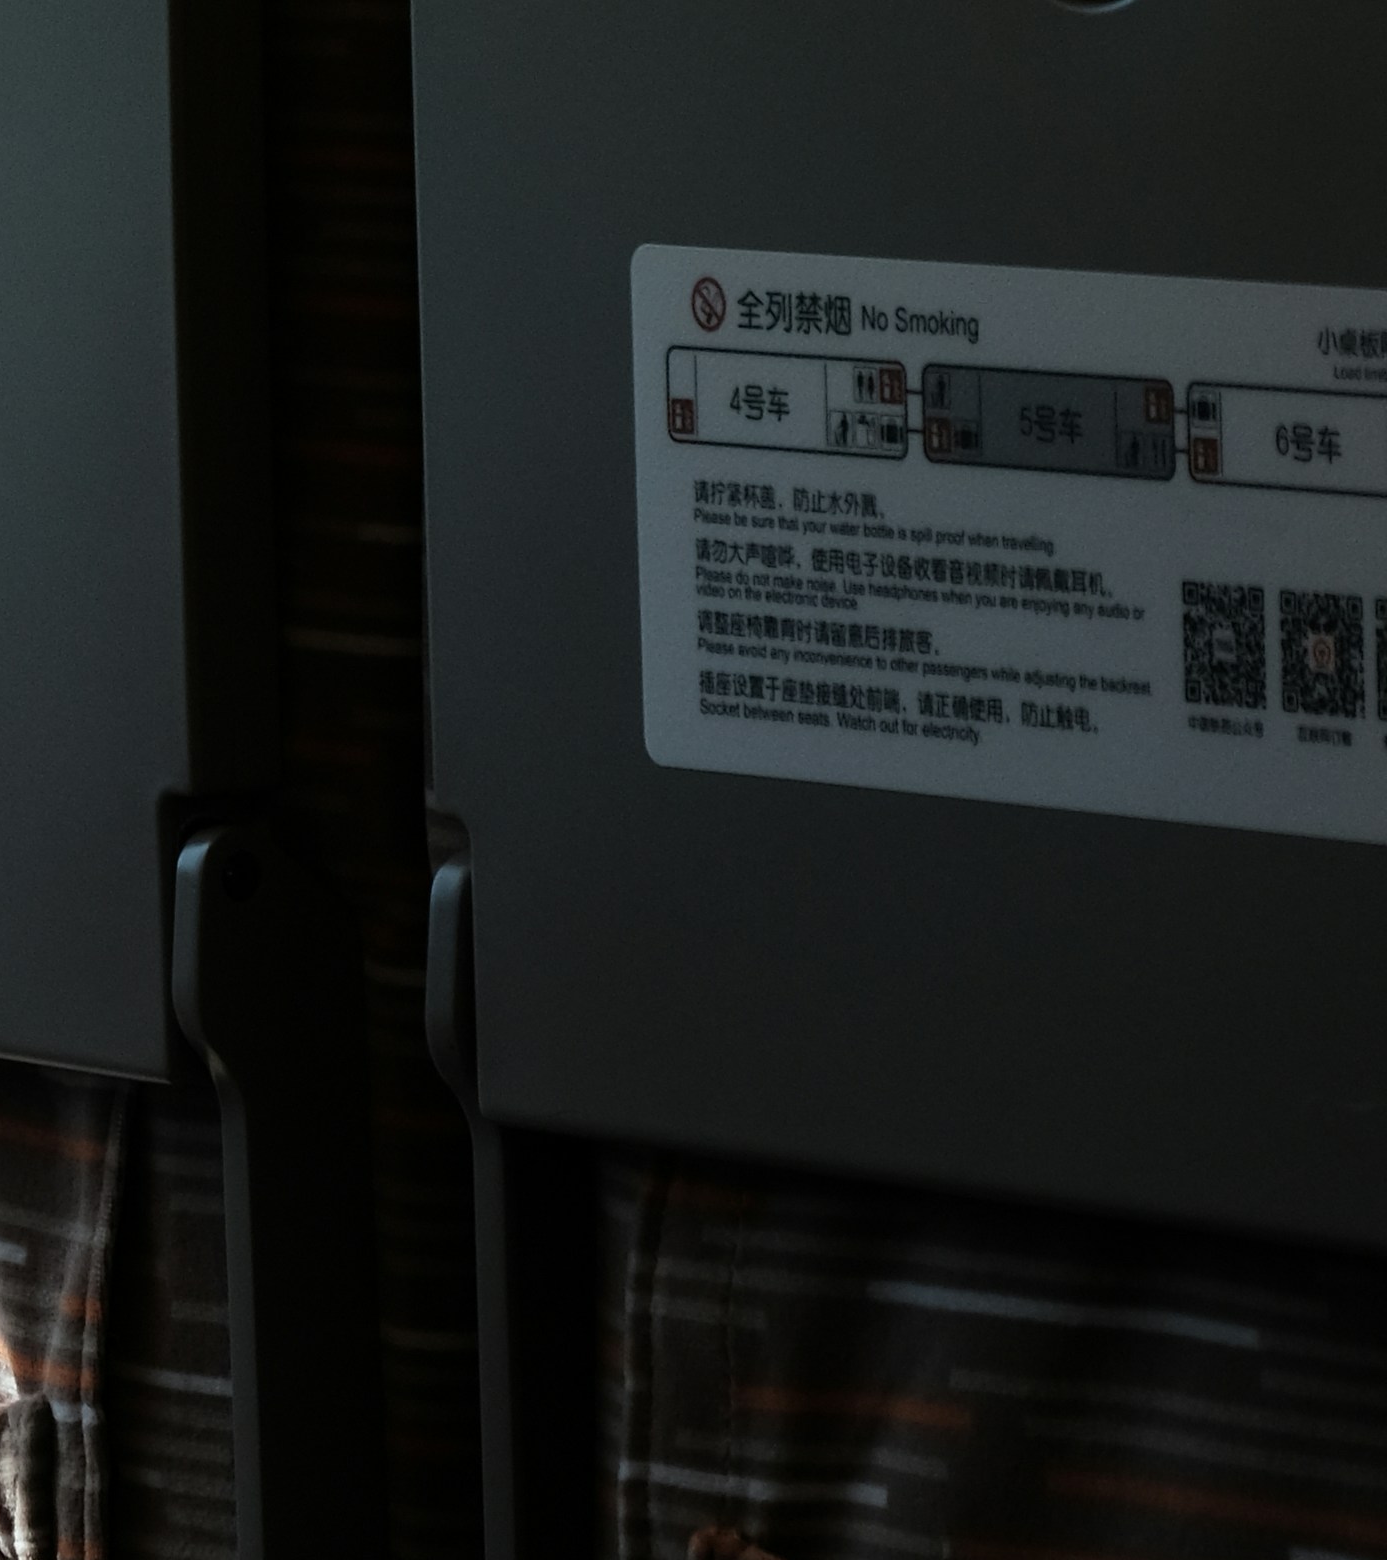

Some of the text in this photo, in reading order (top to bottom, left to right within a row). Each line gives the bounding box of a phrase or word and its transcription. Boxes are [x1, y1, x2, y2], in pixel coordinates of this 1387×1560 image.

[737, 290, 979, 345] 全列禁烟 No Smoking
[729, 384, 790, 422] 4号车
[1019, 404, 1083, 444] 5号车
[1275, 423, 1342, 464] 6号车
